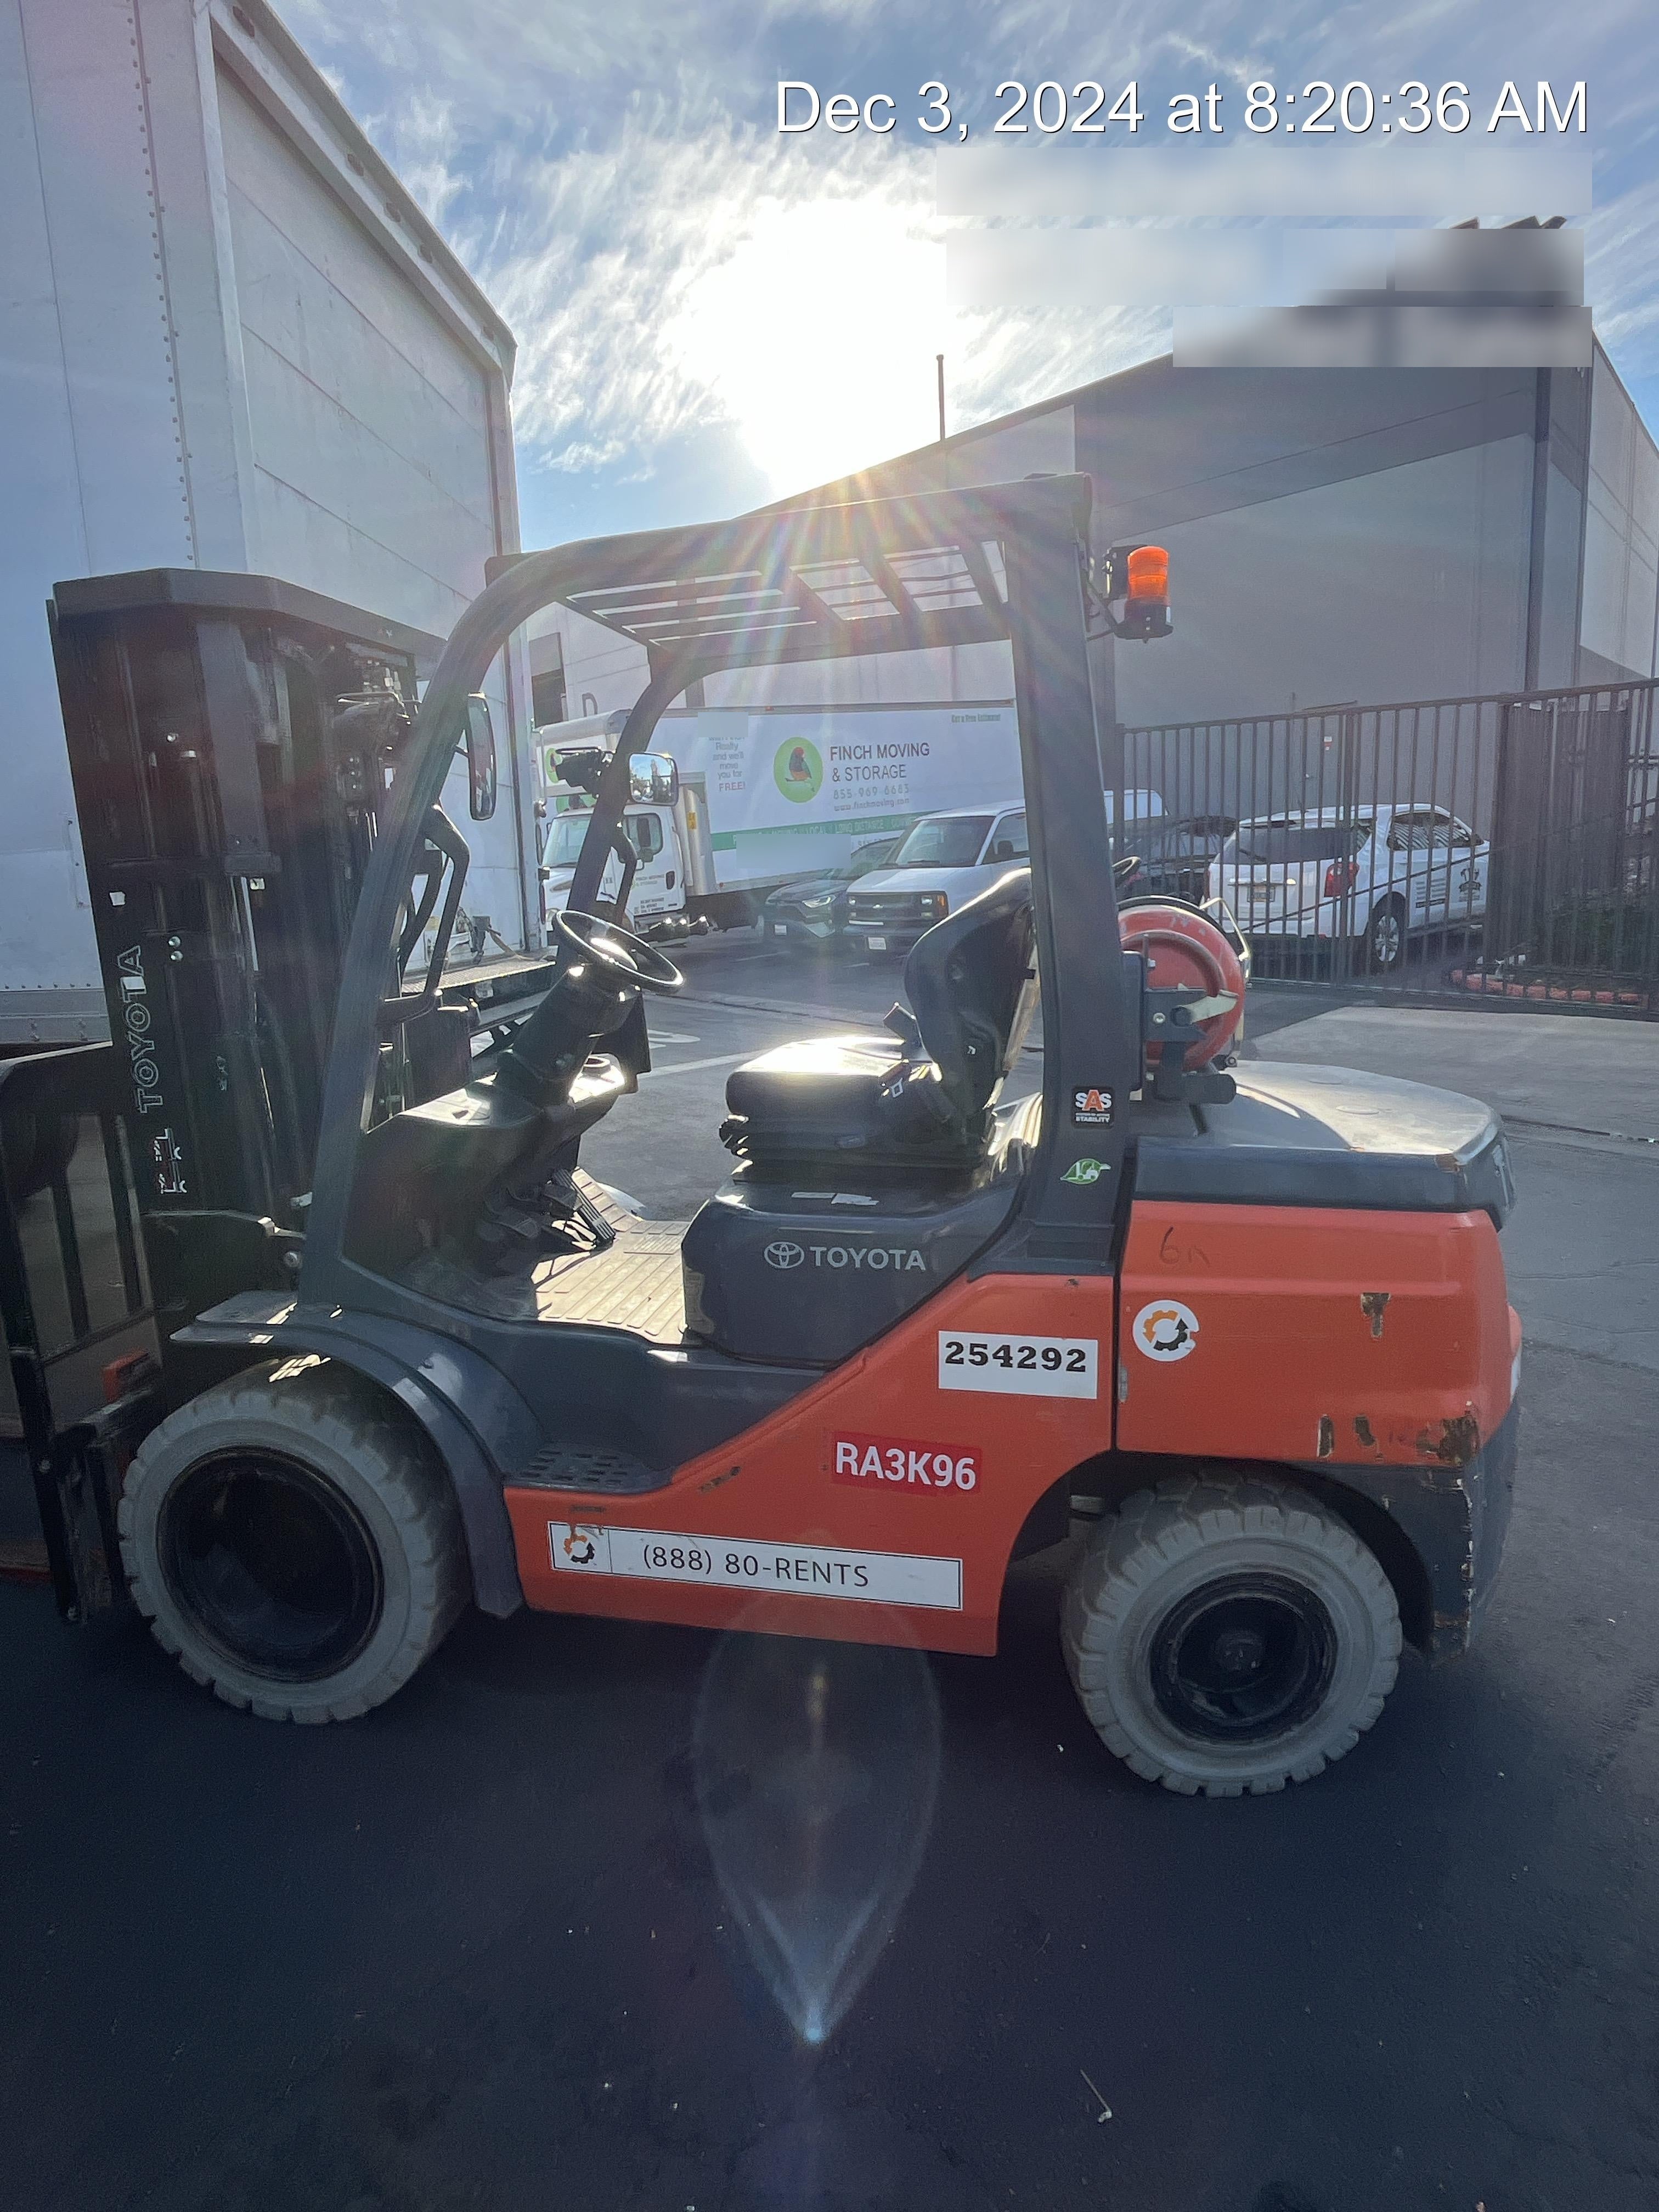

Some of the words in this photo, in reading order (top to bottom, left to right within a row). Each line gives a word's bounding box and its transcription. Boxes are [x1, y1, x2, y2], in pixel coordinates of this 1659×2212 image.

[830, 744, 872, 761] FINCH
[877, 742, 930, 759] MOVING
[718, 771, 731, 780] you
[832, 768, 840, 782] &
[845, 764, 907, 782] STORAGE
[719, 782, 746, 792] FREE!
[117, 945, 163, 1114] TOYOTA
[1075, 1089, 1112, 1111] SAS
[810, 1246, 927, 1271] TOYOTA
[945, 1341, 1086, 1373] 254292
[836, 1441, 976, 1491] RA3K96
[643, 1544, 712, 1575] (888)
[725, 1553, 869, 1588] 80-RENTS
